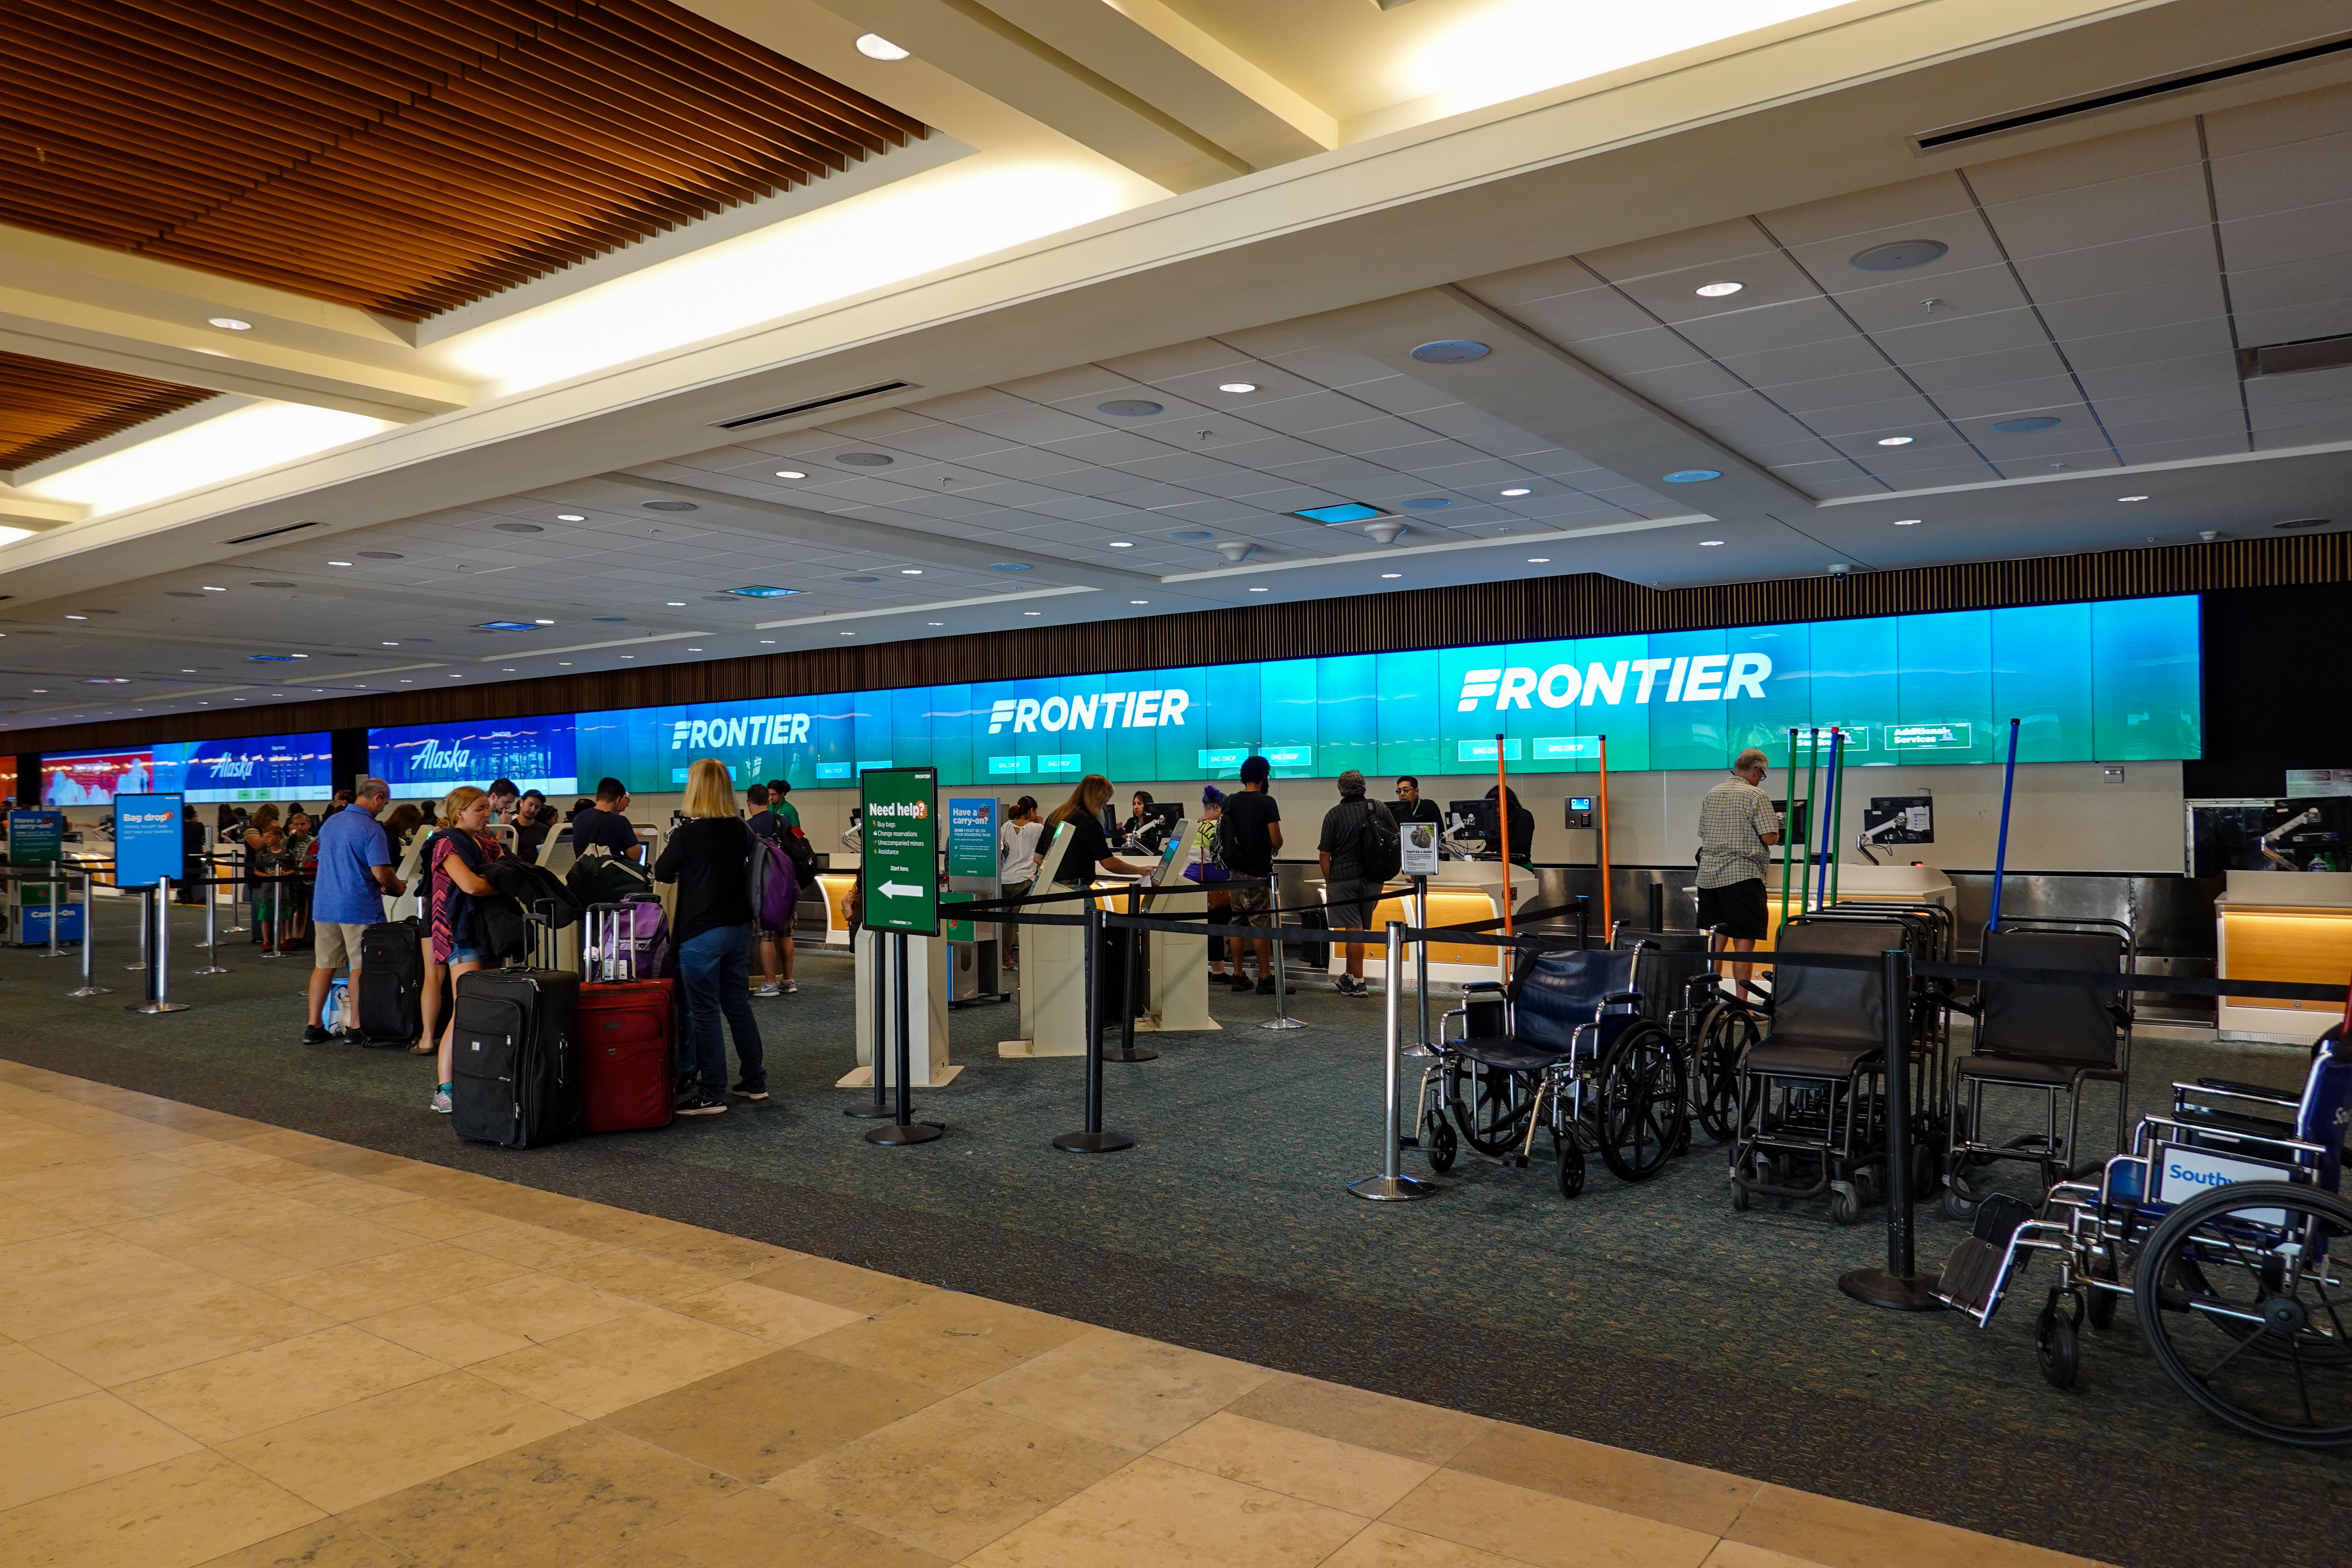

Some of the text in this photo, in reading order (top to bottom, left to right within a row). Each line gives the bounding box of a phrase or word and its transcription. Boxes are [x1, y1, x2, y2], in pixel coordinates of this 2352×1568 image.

[1457, 652, 1773, 712] FRONTIER
[988, 689, 1189, 734] FRONTIER
[672, 713, 811, 749] FRONTIER
[1894, 727, 1946, 735] Additional
[210, 752, 254, 780] Alaska
[410, 739, 471, 772] Alaska
[123, 813, 168, 823] Bag drop
[869, 803, 925, 818] Need help?
[953, 808, 971, 816] Have
[953, 816, 989, 826] carry-on?
